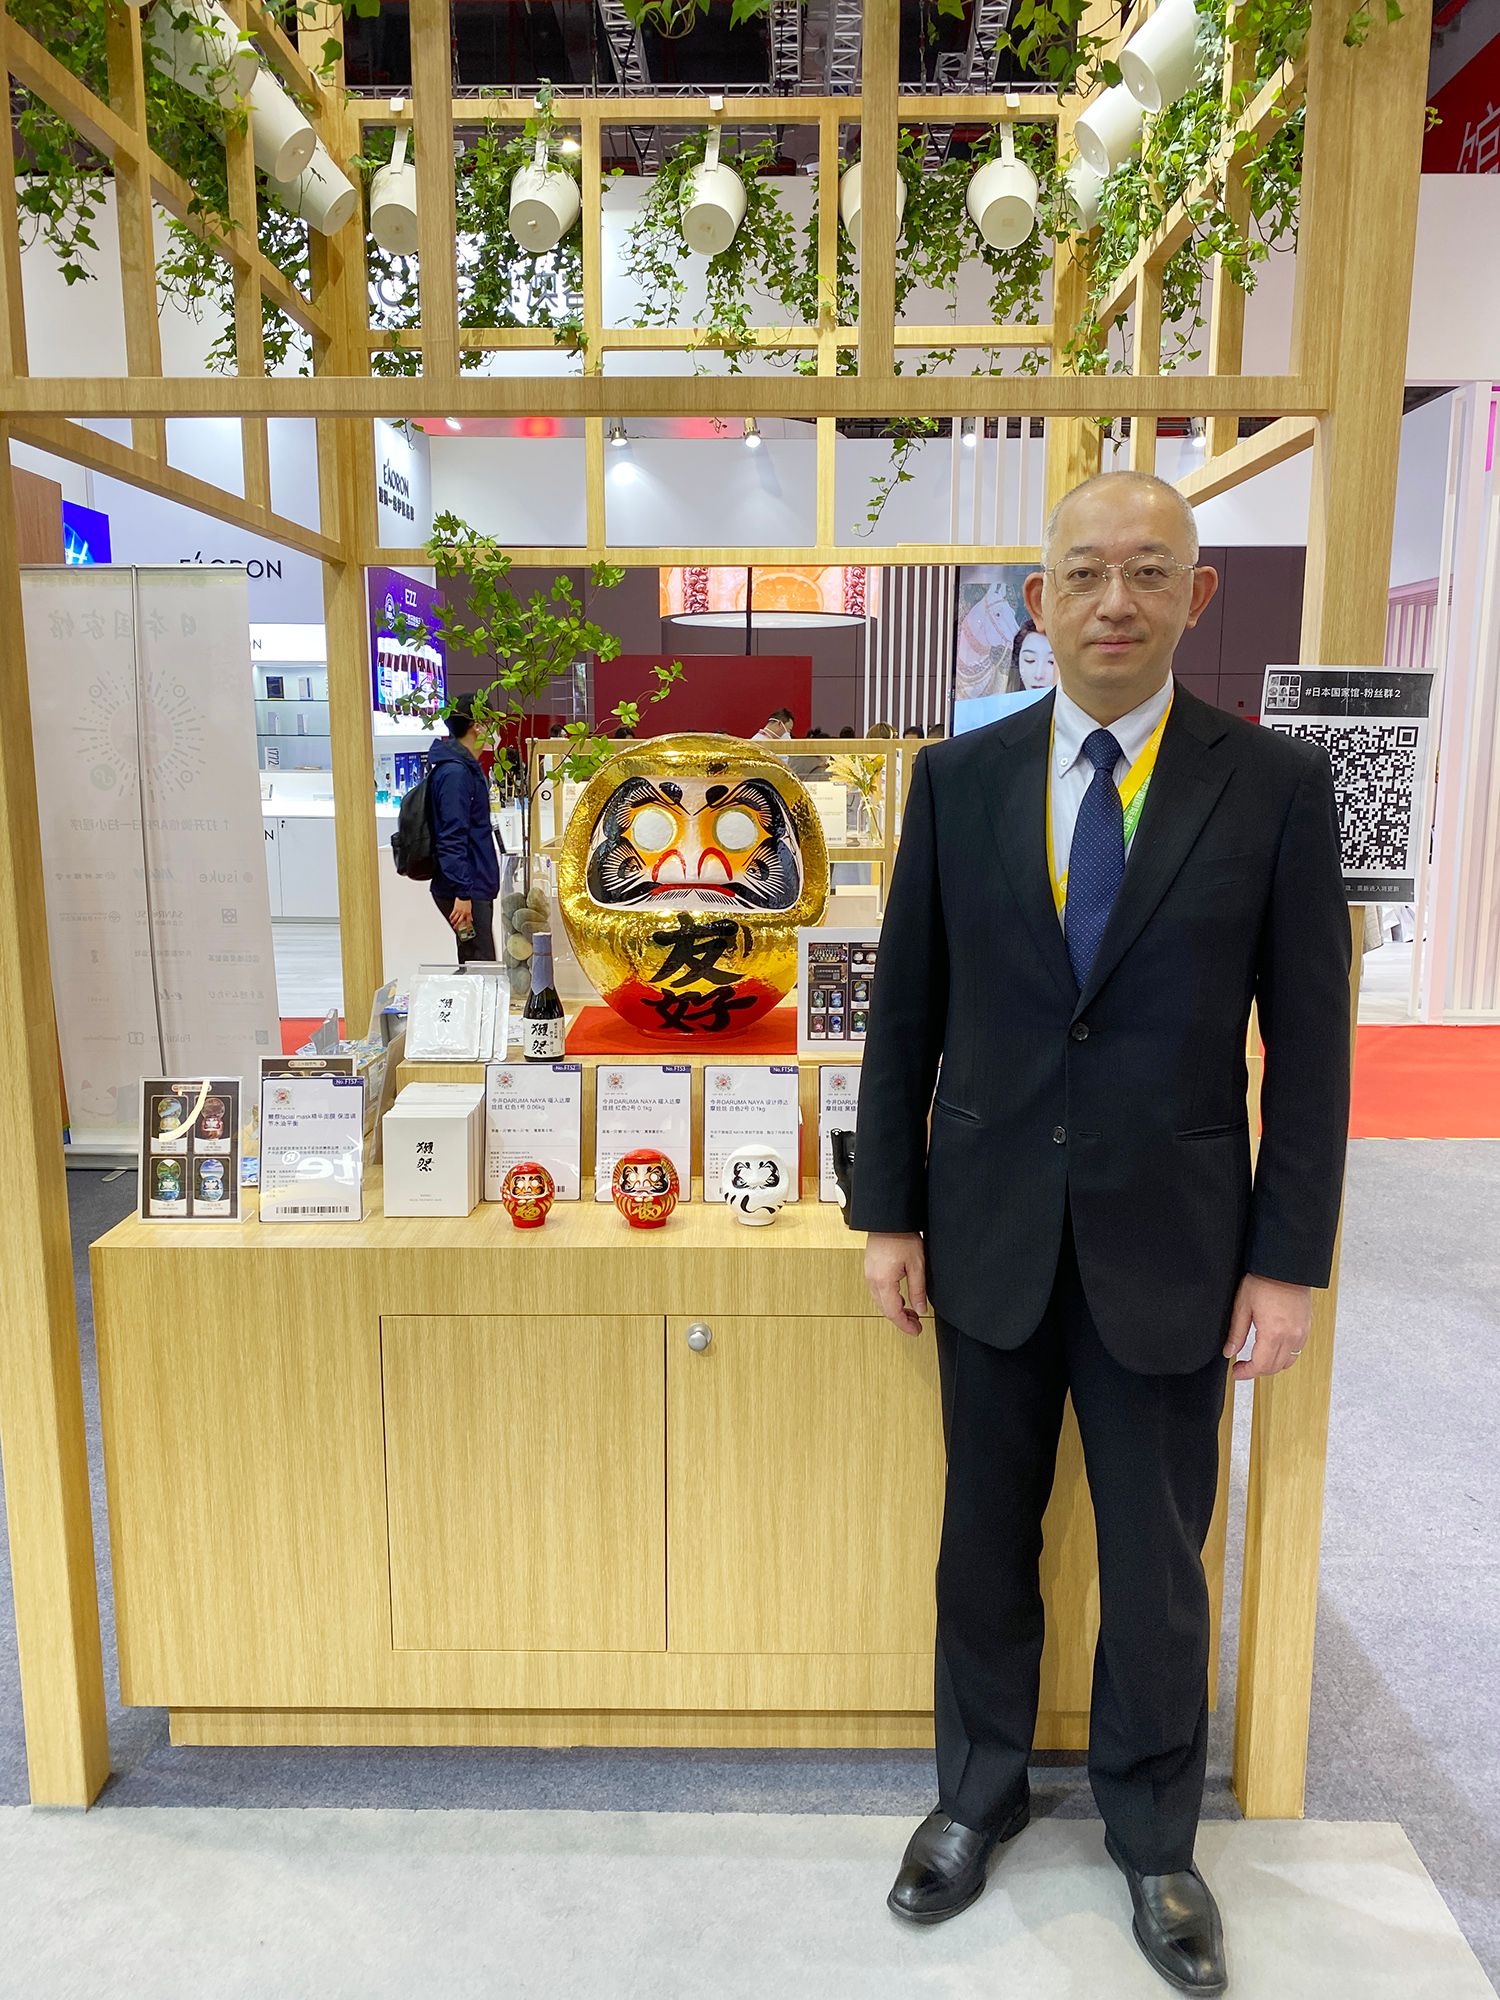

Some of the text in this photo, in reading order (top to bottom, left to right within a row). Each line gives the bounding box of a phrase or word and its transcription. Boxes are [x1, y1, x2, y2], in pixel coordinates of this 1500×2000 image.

[1304, 686, 1402, 700] #日本国家馆-粉丝群2
[641, 912, 757, 1032] 友好
